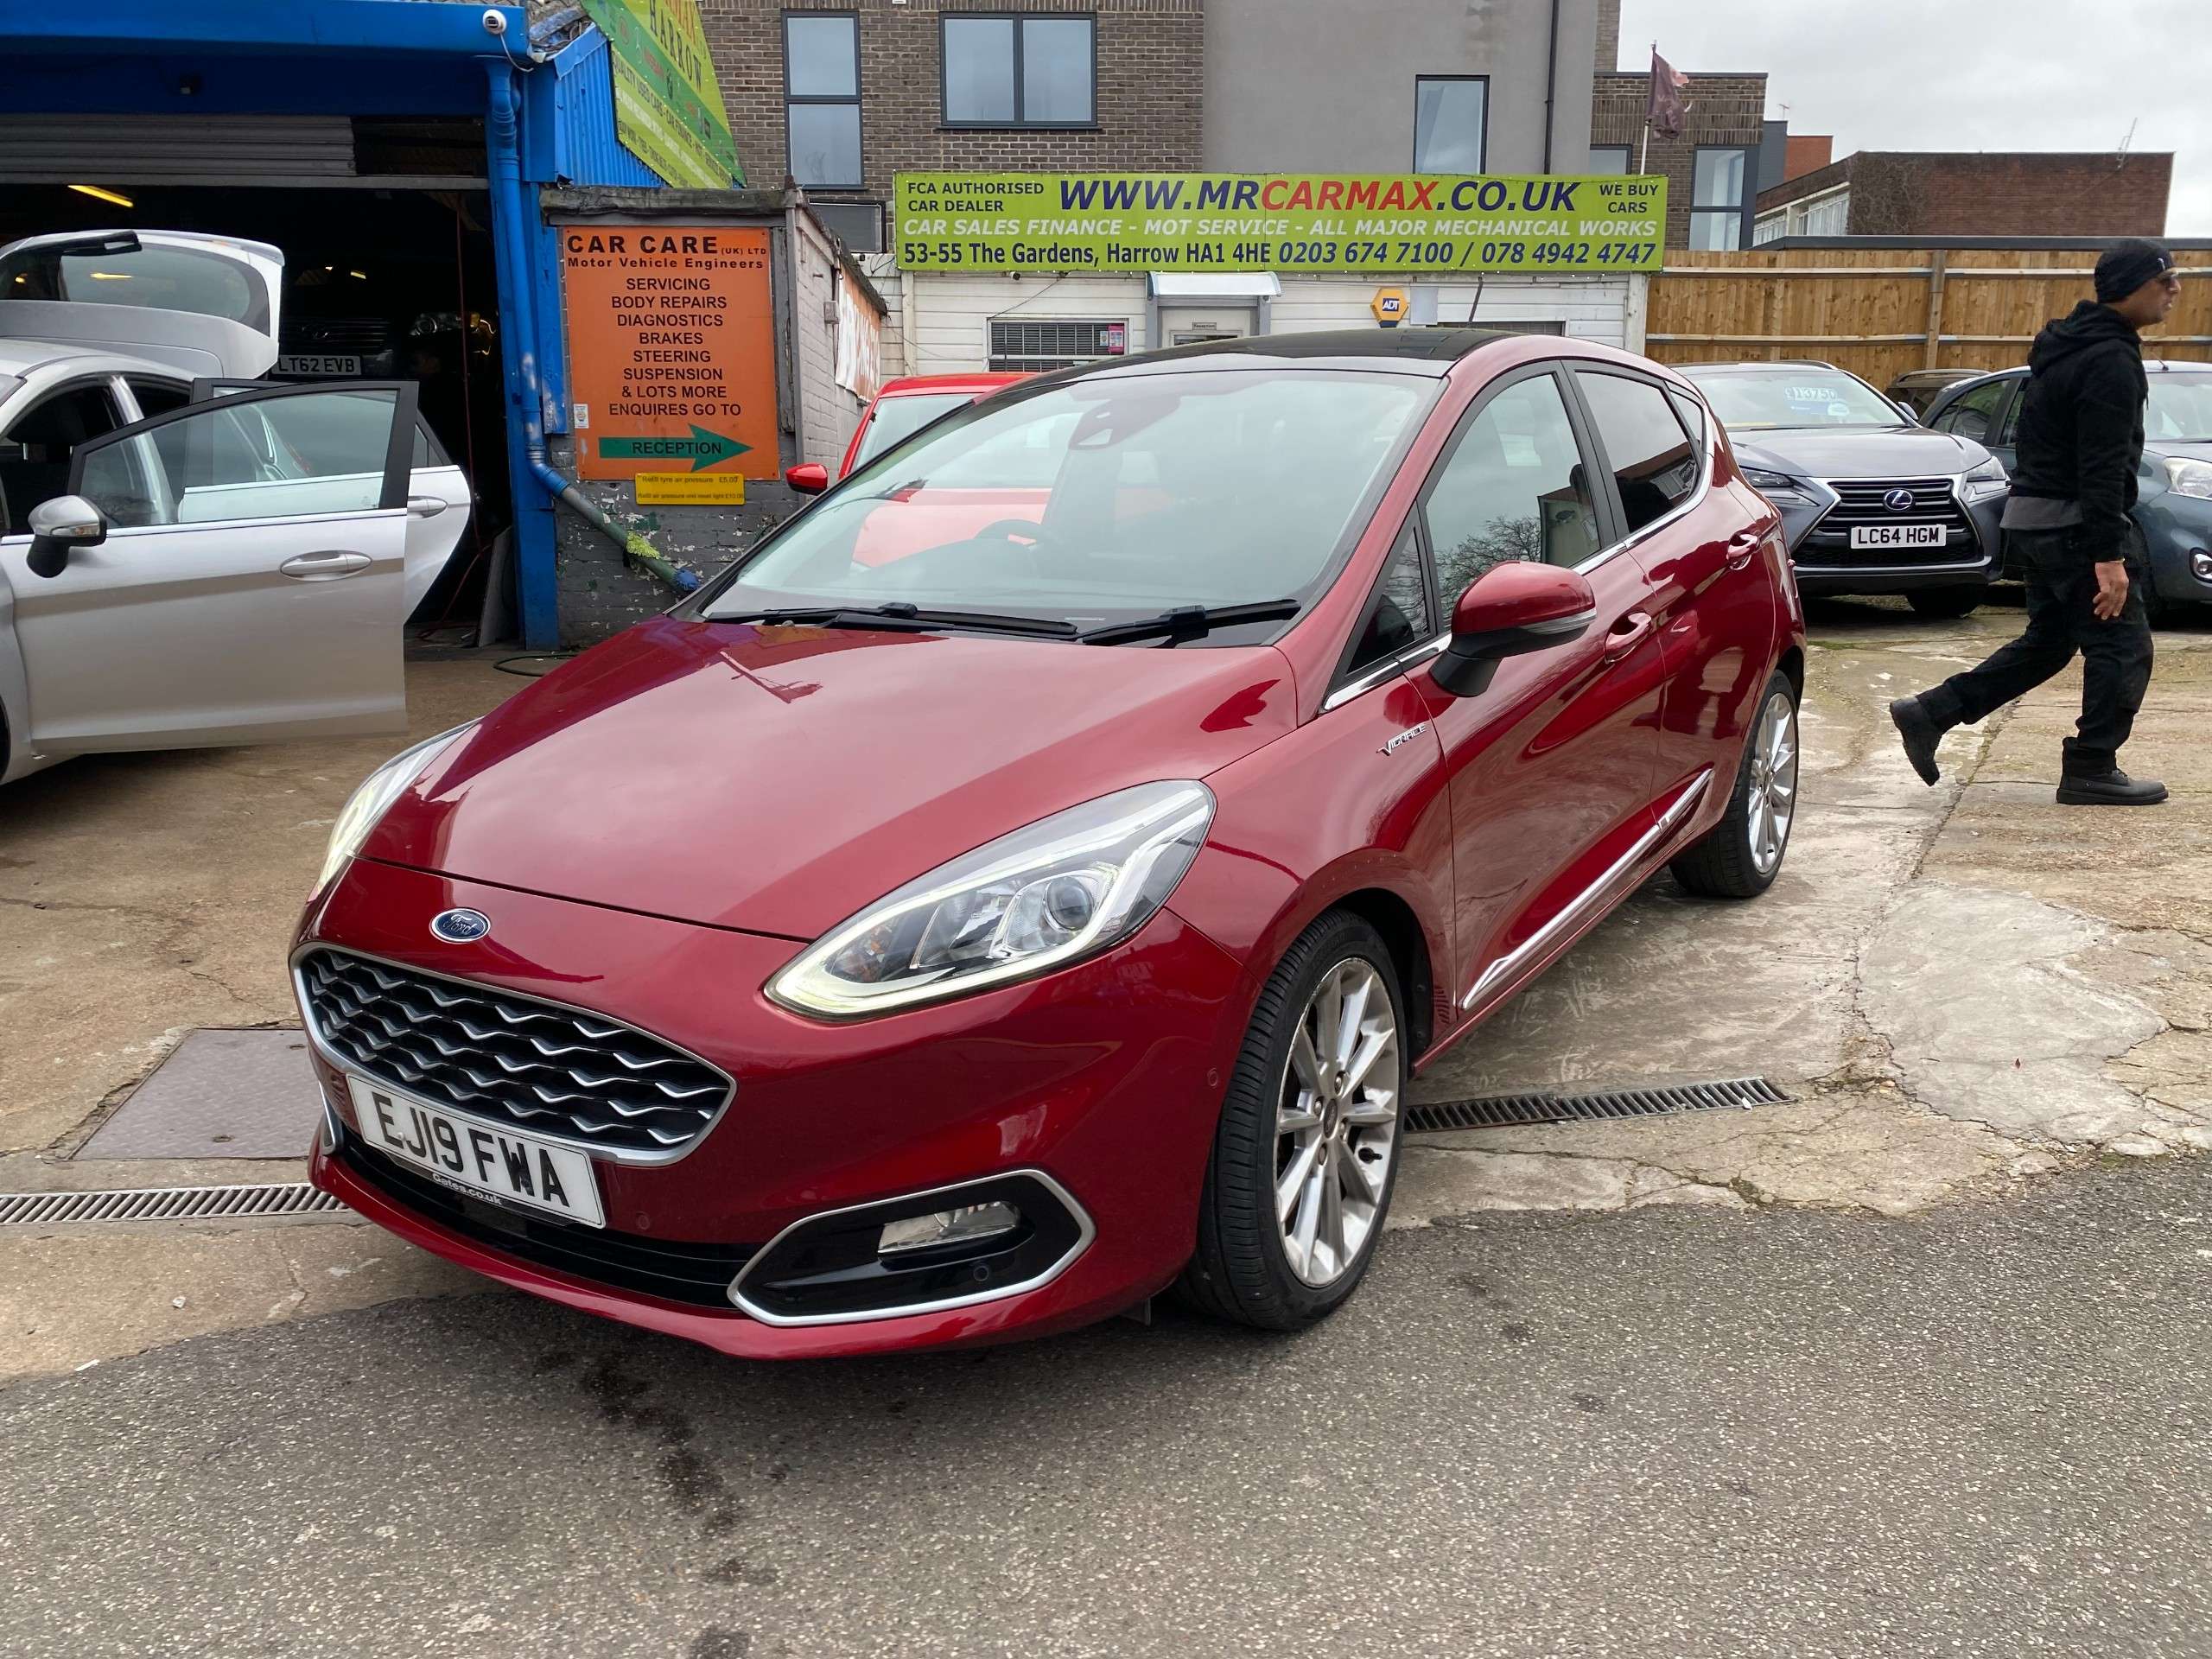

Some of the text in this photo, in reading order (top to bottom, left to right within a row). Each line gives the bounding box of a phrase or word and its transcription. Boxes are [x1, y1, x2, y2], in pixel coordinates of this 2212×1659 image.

[650, 0, 702, 92] HARROW
[908, 180, 1044, 194] FCA AUTHORISED
[1600, 181, 1657, 195] WE BUY
[1061, 180, 1580, 211] WWW.MRCARMAX.CO.UK
[909, 200, 1002, 211] CAR DEALER
[1608, 202, 1647, 213] CARS
[904, 219, 946, 236] CAR
[954, 219, 1020, 235] SALES
[1027, 219, 1122, 237] FINANCE
[1145, 219, 1192, 235] MOT
[1198, 219, 1288, 235] SERVICE
[1310, 220, 1346, 236] ALL
[1355, 220, 1427, 236] MAJOR
[1434, 220, 1569, 236] MECHANICAL
[1580, 221, 1656, 237] WORKS
[566, 235, 625, 252] CAR
[640, 236, 717, 253] CARE
[905, 242, 1656, 267] 53-55 The Gardens, Harrow HA1 4HE 0203 674 7100 / 078 4942 4747
[569, 257, 762, 270] Motor Vehicle Engineers
[627, 278, 709, 290] SERVICING
[612, 296, 727, 308] BODY REPAIRS
[1382, 300, 1400, 310] ADT
[618, 315, 722, 326] DIAGNOSTICS
[639, 333, 702, 344] BRAKES
[634, 351, 710, 362] STEERING
[278, 357, 355, 372] LT62 EVB
[624, 368, 722, 380] SUSPENSION
[622, 386, 726, 397] & LOTS MORE
[610, 404, 741, 416] ENQUIRES GO TO
[632, 442, 721, 454] RECEPTION
[1857, 527, 1939, 544] LC64 HGM
[372, 1091, 570, 1207] EJ19 FWA
